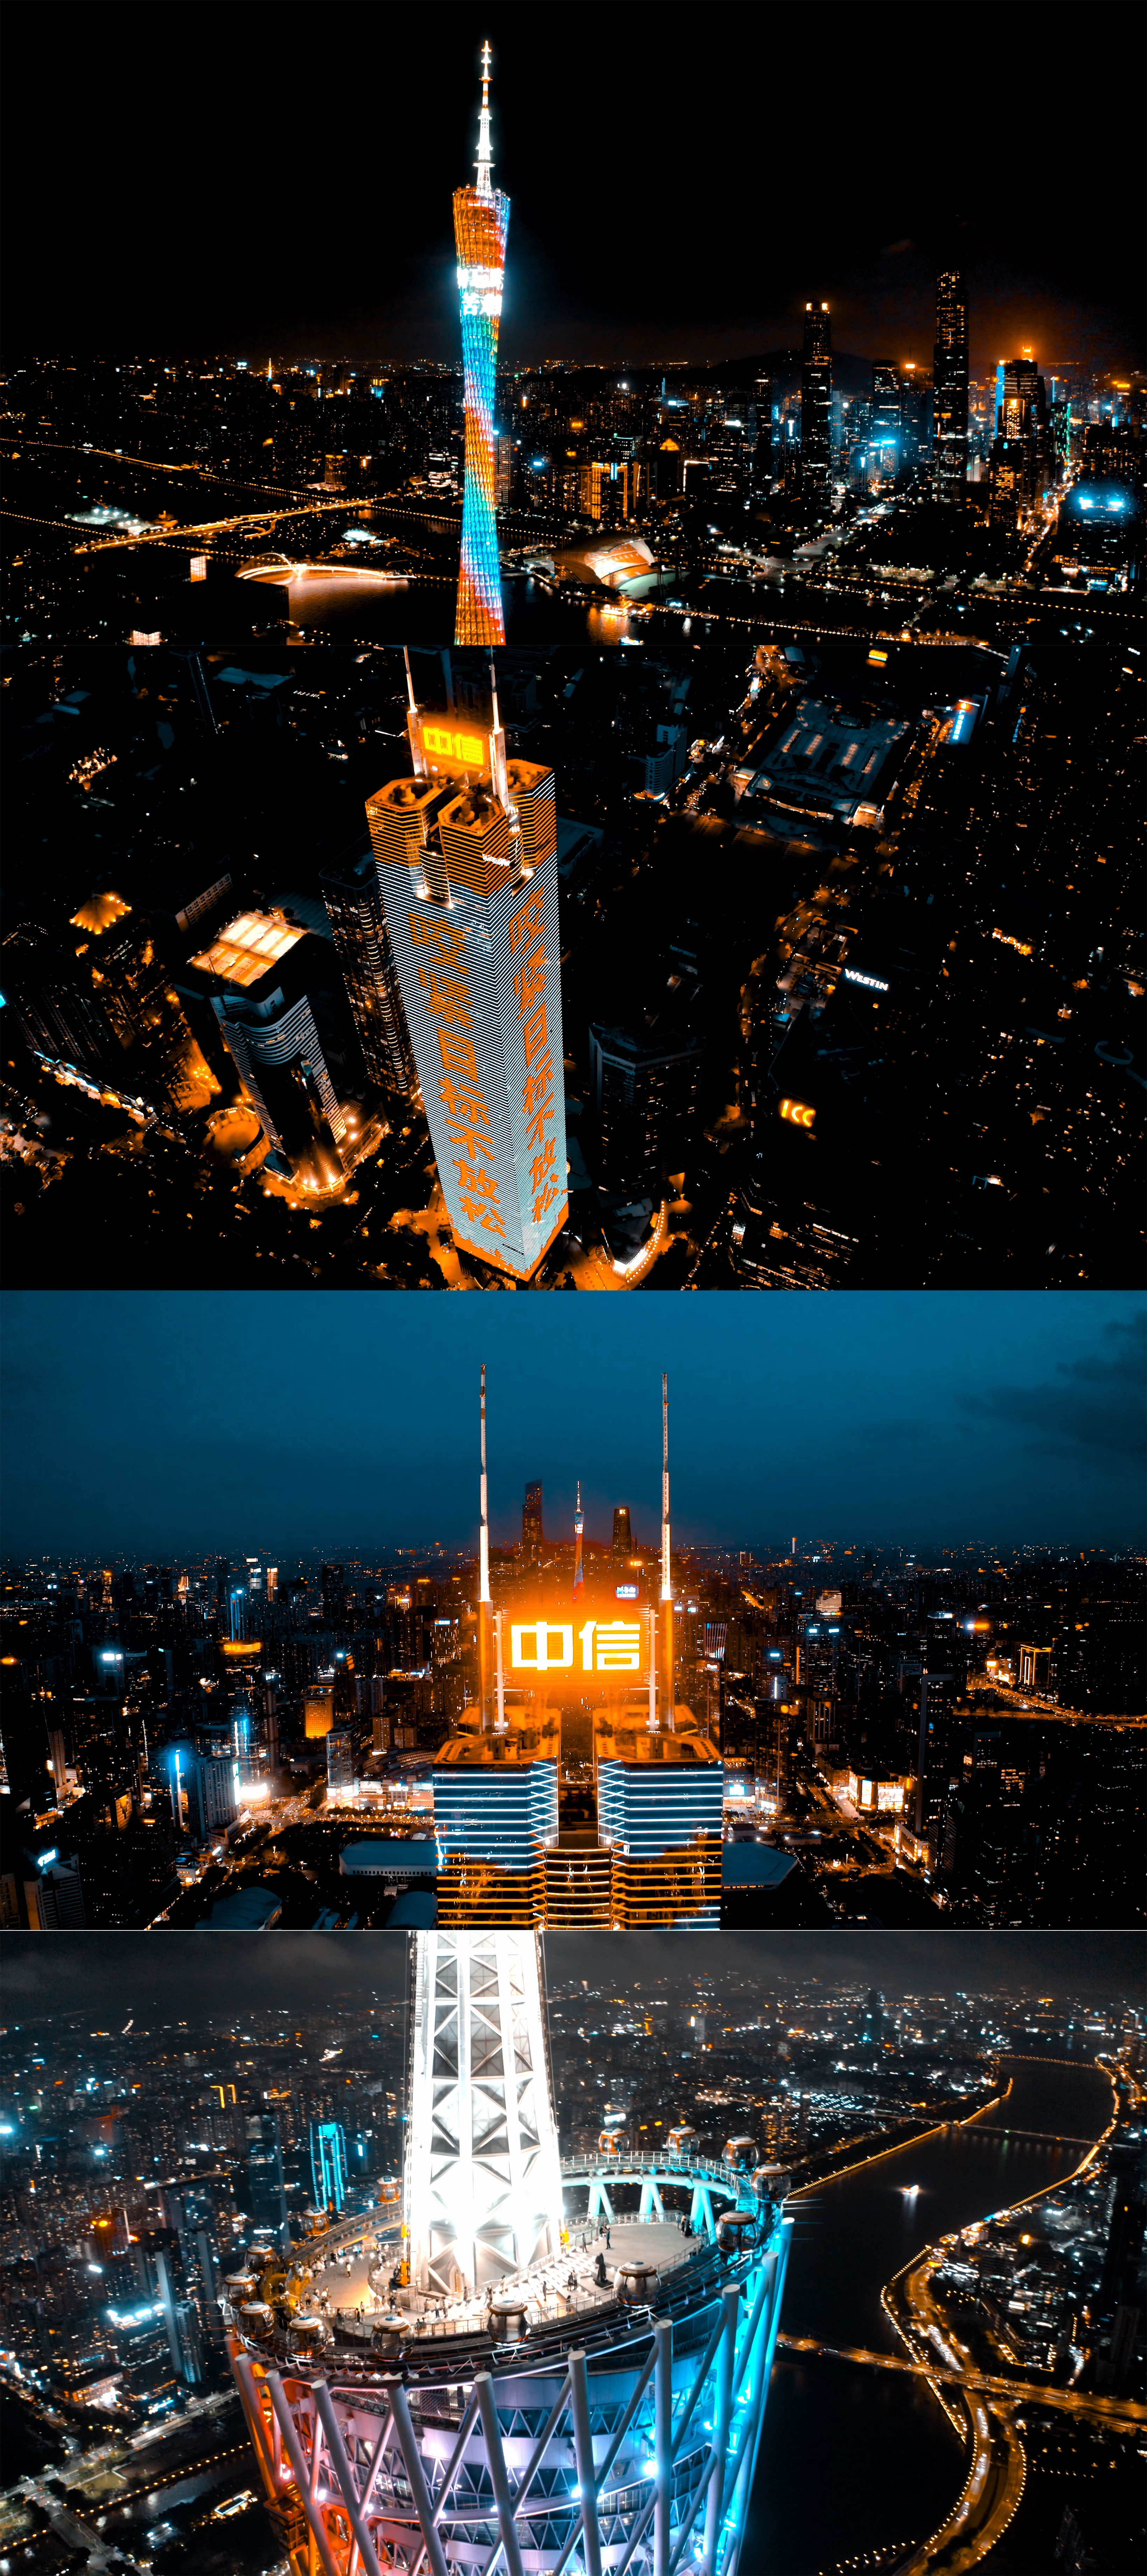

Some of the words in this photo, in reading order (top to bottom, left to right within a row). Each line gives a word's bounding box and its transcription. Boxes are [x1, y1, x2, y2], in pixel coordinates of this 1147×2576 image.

[423, 726, 484, 765] 中信
[844, 968, 889, 991] WESTIN
[408, 913, 506, 1238] 咬紧目标不放松
[509, 886, 559, 1223] 咬紧目标不放松
[781, 1101, 814, 1126] ICC
[511, 1621, 641, 1670] 中信
